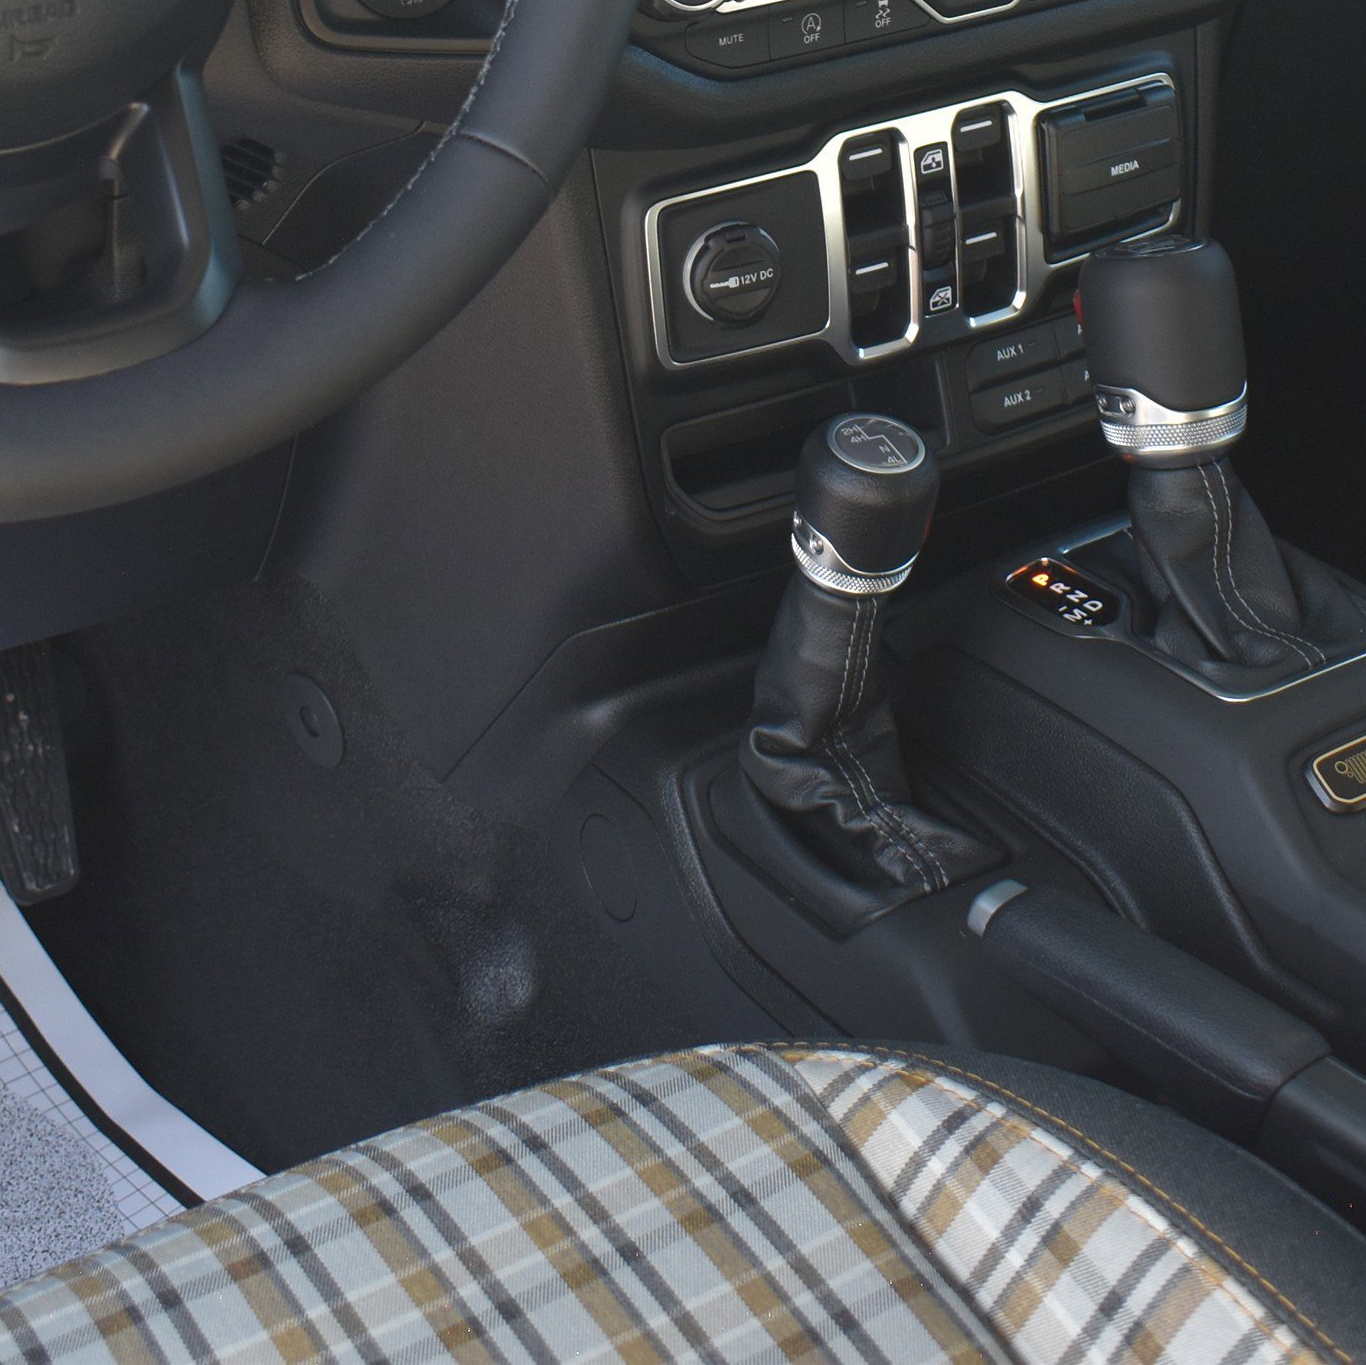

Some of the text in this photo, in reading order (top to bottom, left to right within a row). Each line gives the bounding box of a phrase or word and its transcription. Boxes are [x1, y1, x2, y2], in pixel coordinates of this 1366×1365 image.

[875, 17, 891, 28] OFF
[719, 33, 744, 46] MUTE
[804, 33, 820, 44] OFF
[1110, 159, 1139, 177] MEDIA
[740, 268, 774, 285] 12V DC
[996, 343, 1024, 362] AUX 1
[1003, 389, 1032, 408] AUX 2
[841, 426, 859, 436] 2H
[850, 434, 867, 444] 4H
[879, 444, 891, 453] N
[887, 455, 902, 464] 4L
[1031, 573, 1049, 586] P
[1049, 582, 1071, 594] R
[1066, 589, 1088, 603] N
[1083, 600, 1103, 612] D
[1063, 608, 1088, 623] M
